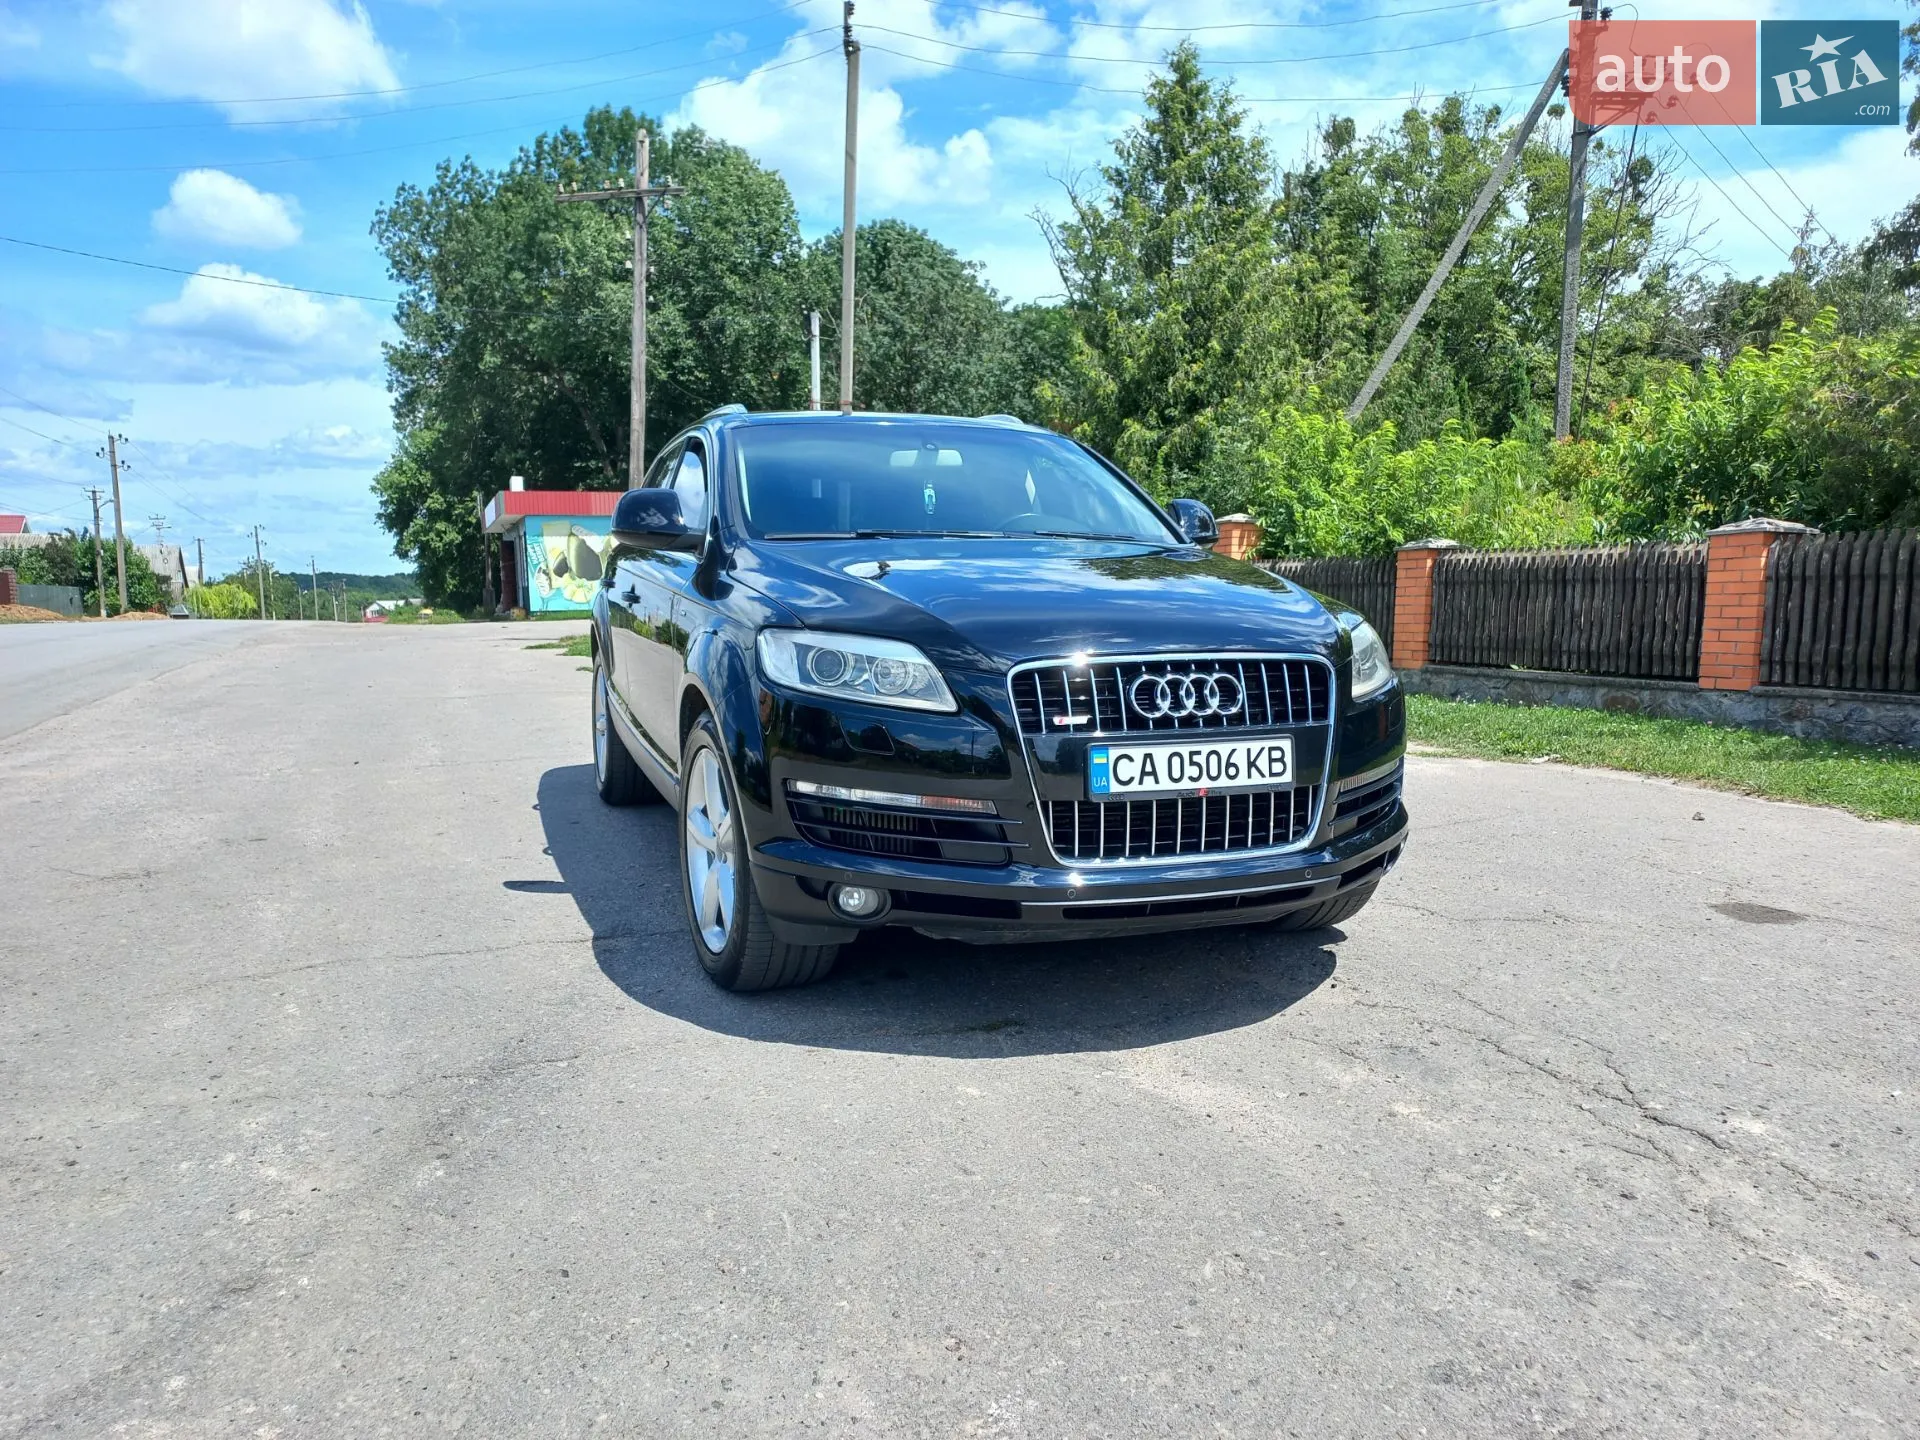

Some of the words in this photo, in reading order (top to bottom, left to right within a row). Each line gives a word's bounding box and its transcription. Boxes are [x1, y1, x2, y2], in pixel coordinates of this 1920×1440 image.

[1112, 753, 1160, 786] CA
[1167, 748, 1240, 783] 0506
[1246, 745, 1287, 779] KB
[1093, 776, 1108, 787] UA
